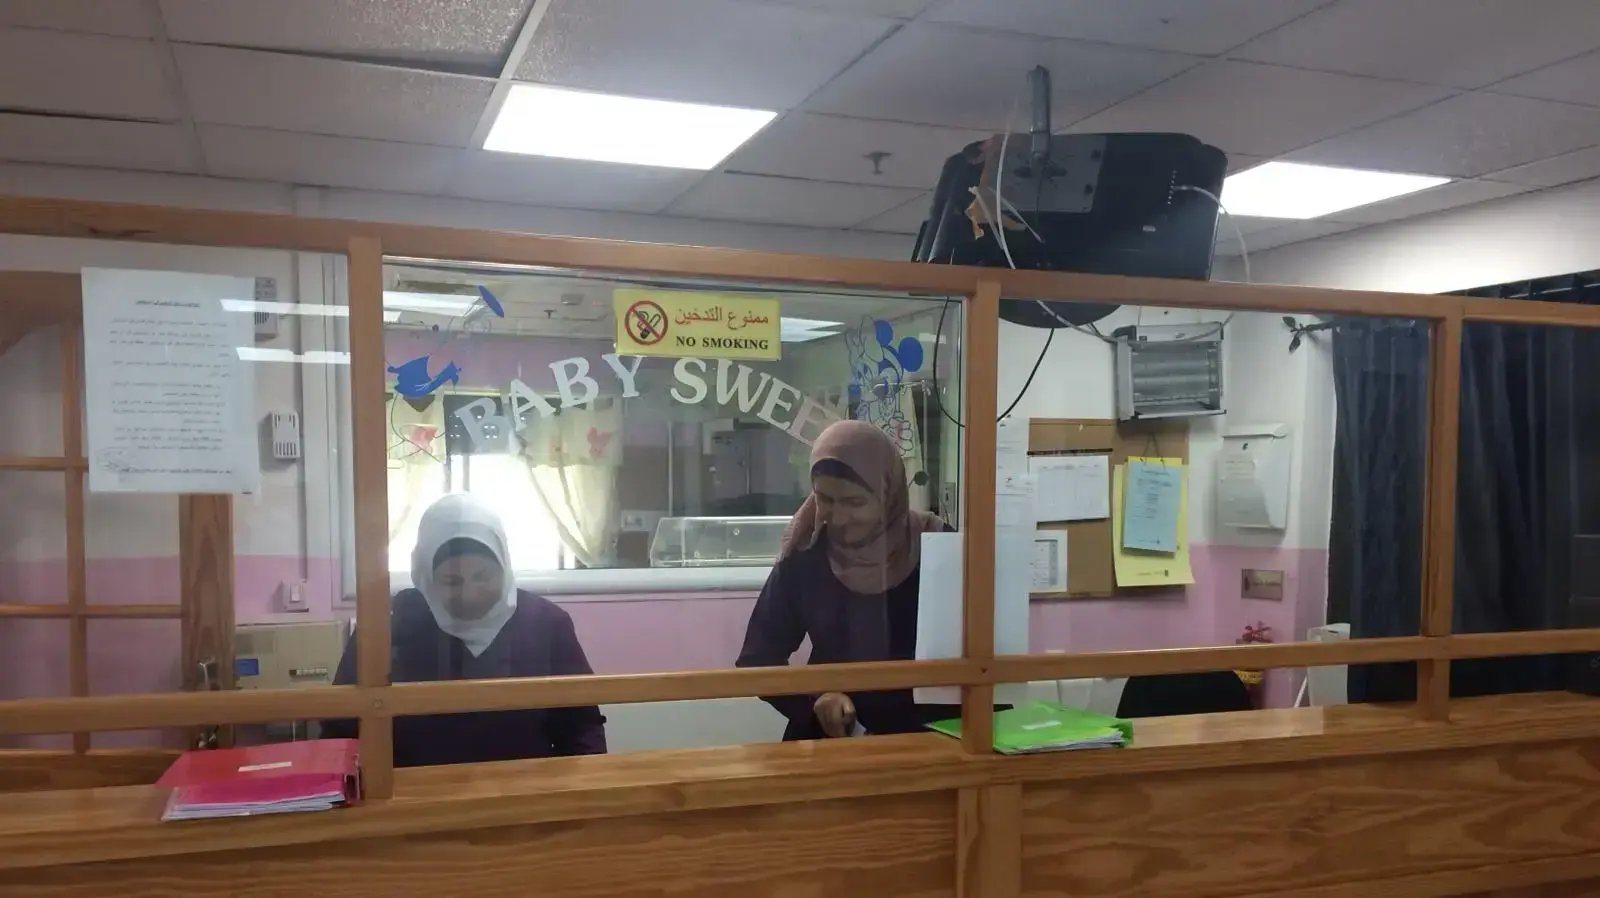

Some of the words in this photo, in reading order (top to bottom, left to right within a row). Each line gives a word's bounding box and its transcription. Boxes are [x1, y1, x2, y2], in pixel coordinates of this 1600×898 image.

[674, 305, 723, 325] التدخين
[727, 309, 769, 330] ممنوع
[676, 336, 696, 347] NO
[702, 336, 769, 350] SMOKING
[454, 353, 648, 453] BABY
